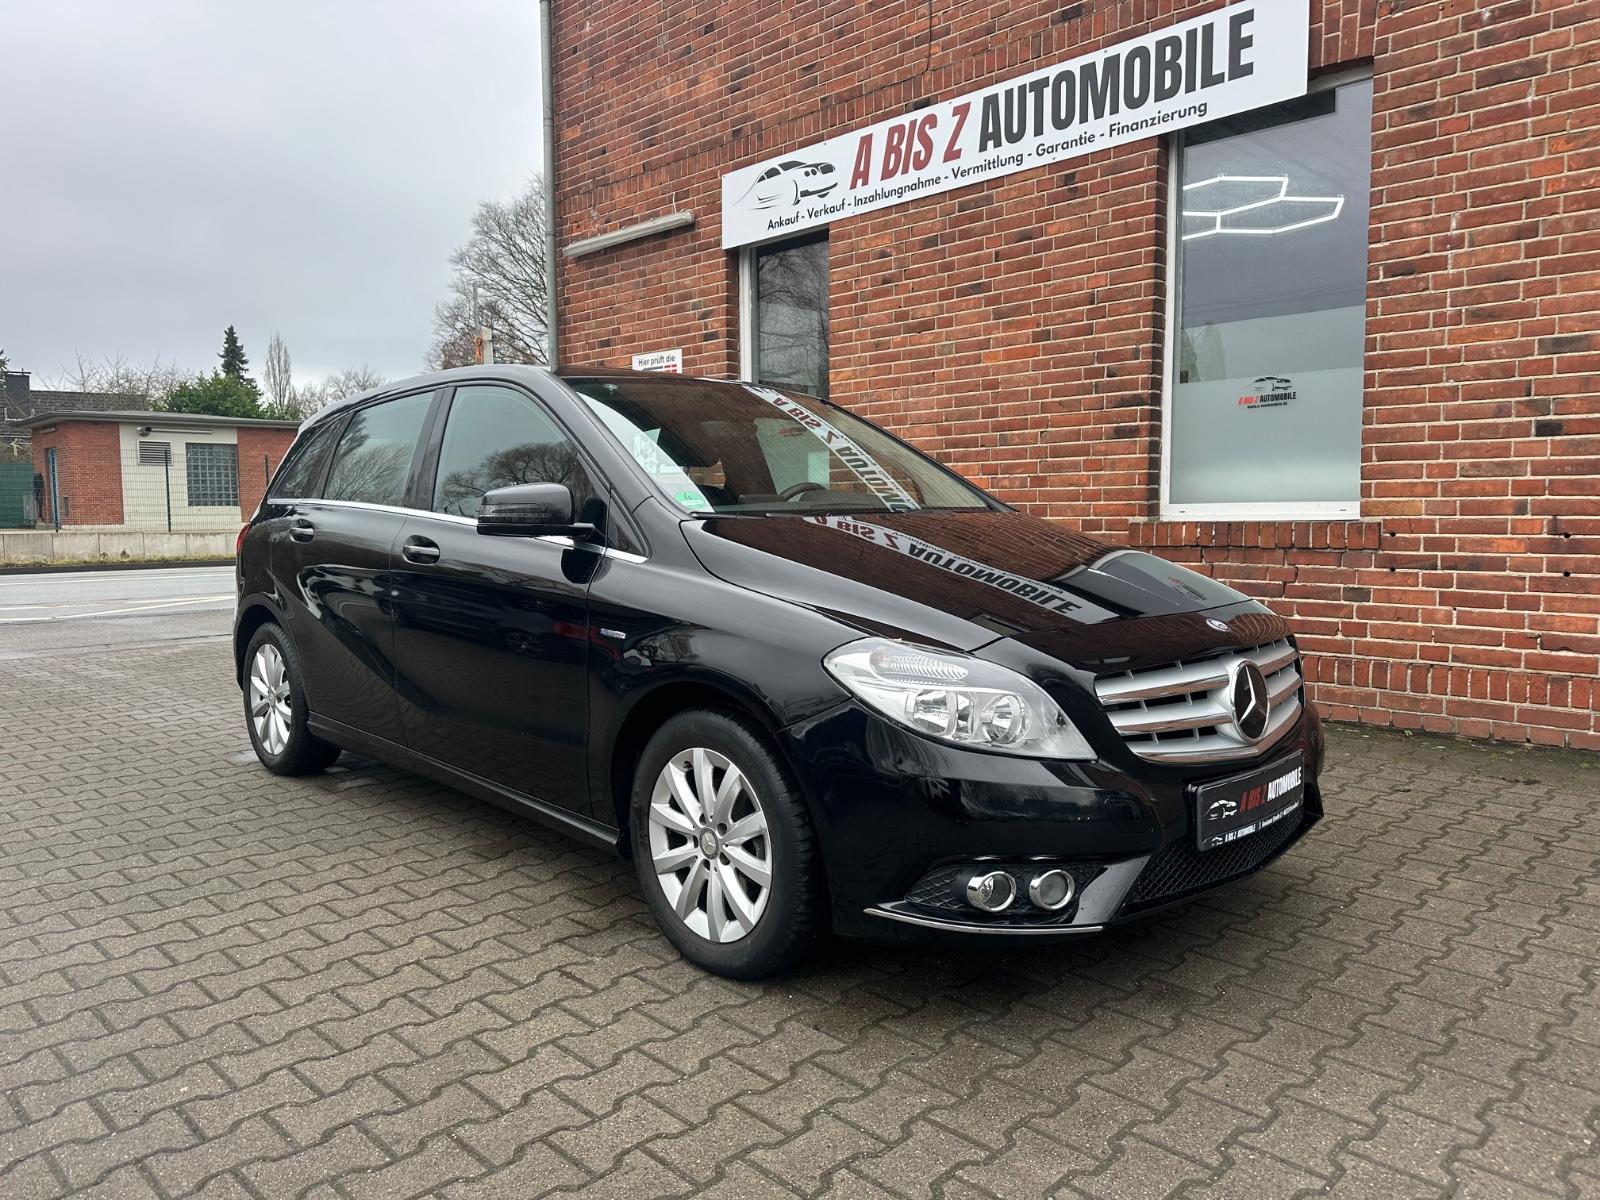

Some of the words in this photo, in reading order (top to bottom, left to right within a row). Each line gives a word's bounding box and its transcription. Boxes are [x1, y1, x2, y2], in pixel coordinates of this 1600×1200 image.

[849, 133, 874, 191] A
[879, 112, 938, 182] BIS
[942, 101, 972, 164] Z
[978, 11, 1255, 154] AUTOMOBILE
[767, 211, 800, 231] Ankauf
[806, 197, 846, 222] Verkauf
[853, 176, 942, 208] Inzahlungnahme
[951, 152, 1024, 180] Vermittlung
[1035, 130, 1096, 157] Garantie
[1108, 102, 1208, 138] Finanzierung
[638, 358, 649, 366] Hier
[650, 355, 665, 365] prüft
[1259, 391, 1297, 403] AUTOMOBILE
